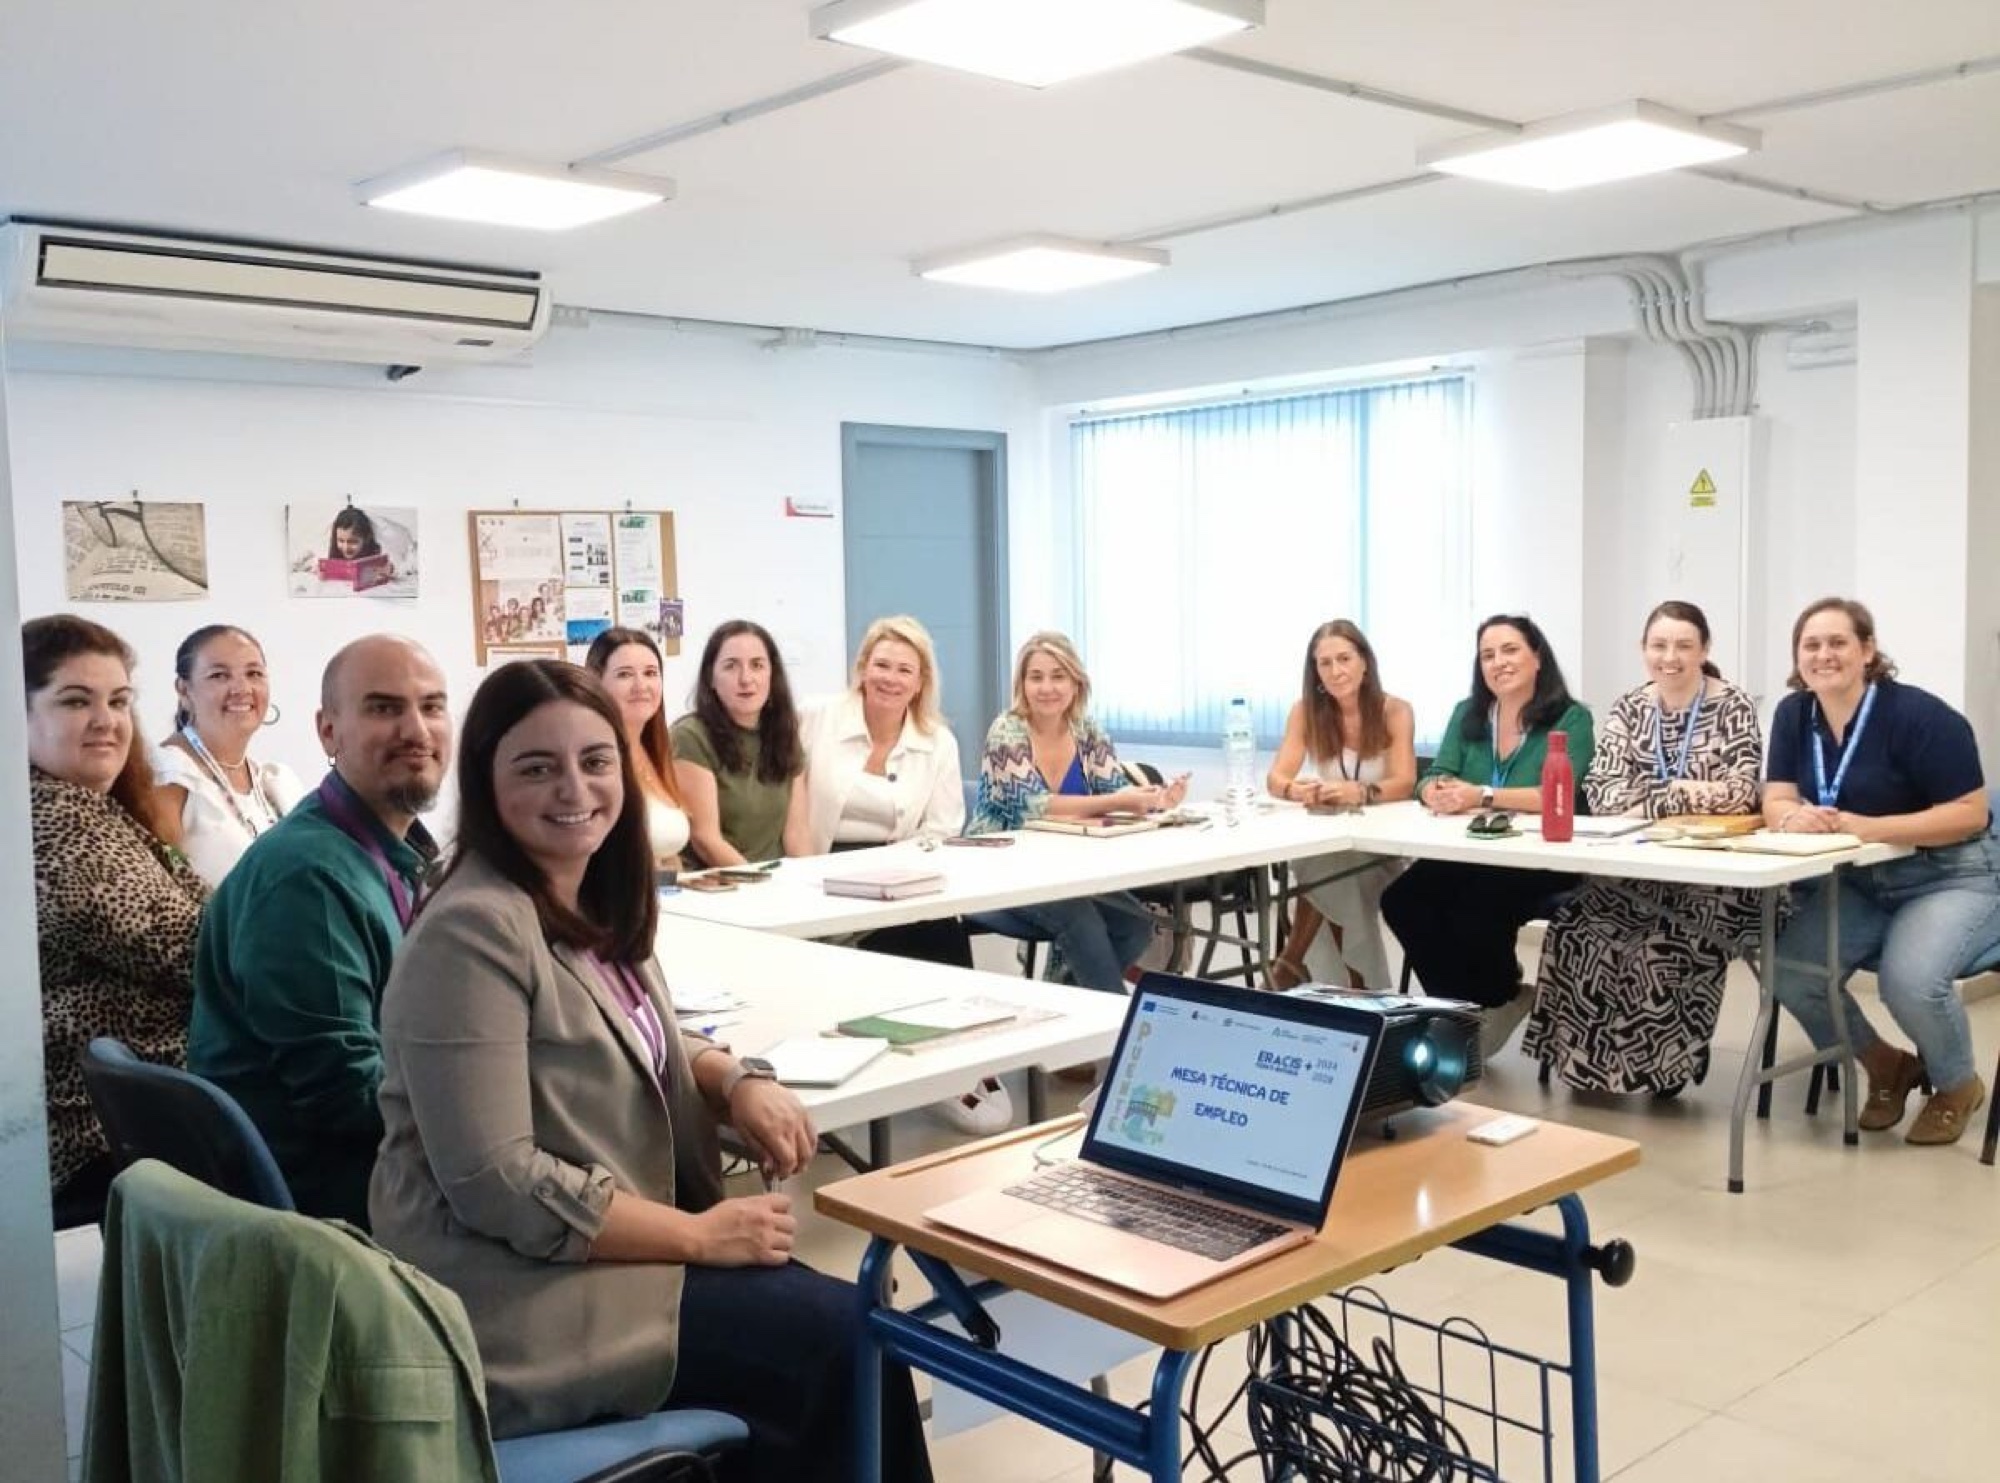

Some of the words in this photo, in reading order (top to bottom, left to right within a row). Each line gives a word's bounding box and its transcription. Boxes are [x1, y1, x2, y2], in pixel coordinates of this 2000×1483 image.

[1257, 1050, 1303, 1069] ERACIS
[1170, 1065, 1207, 1085] MESA
[1211, 1072, 1266, 1100] TÉCNICA
[1268, 1089, 1290, 1106] DE
[1194, 1102, 1248, 1127] EMPLEO
